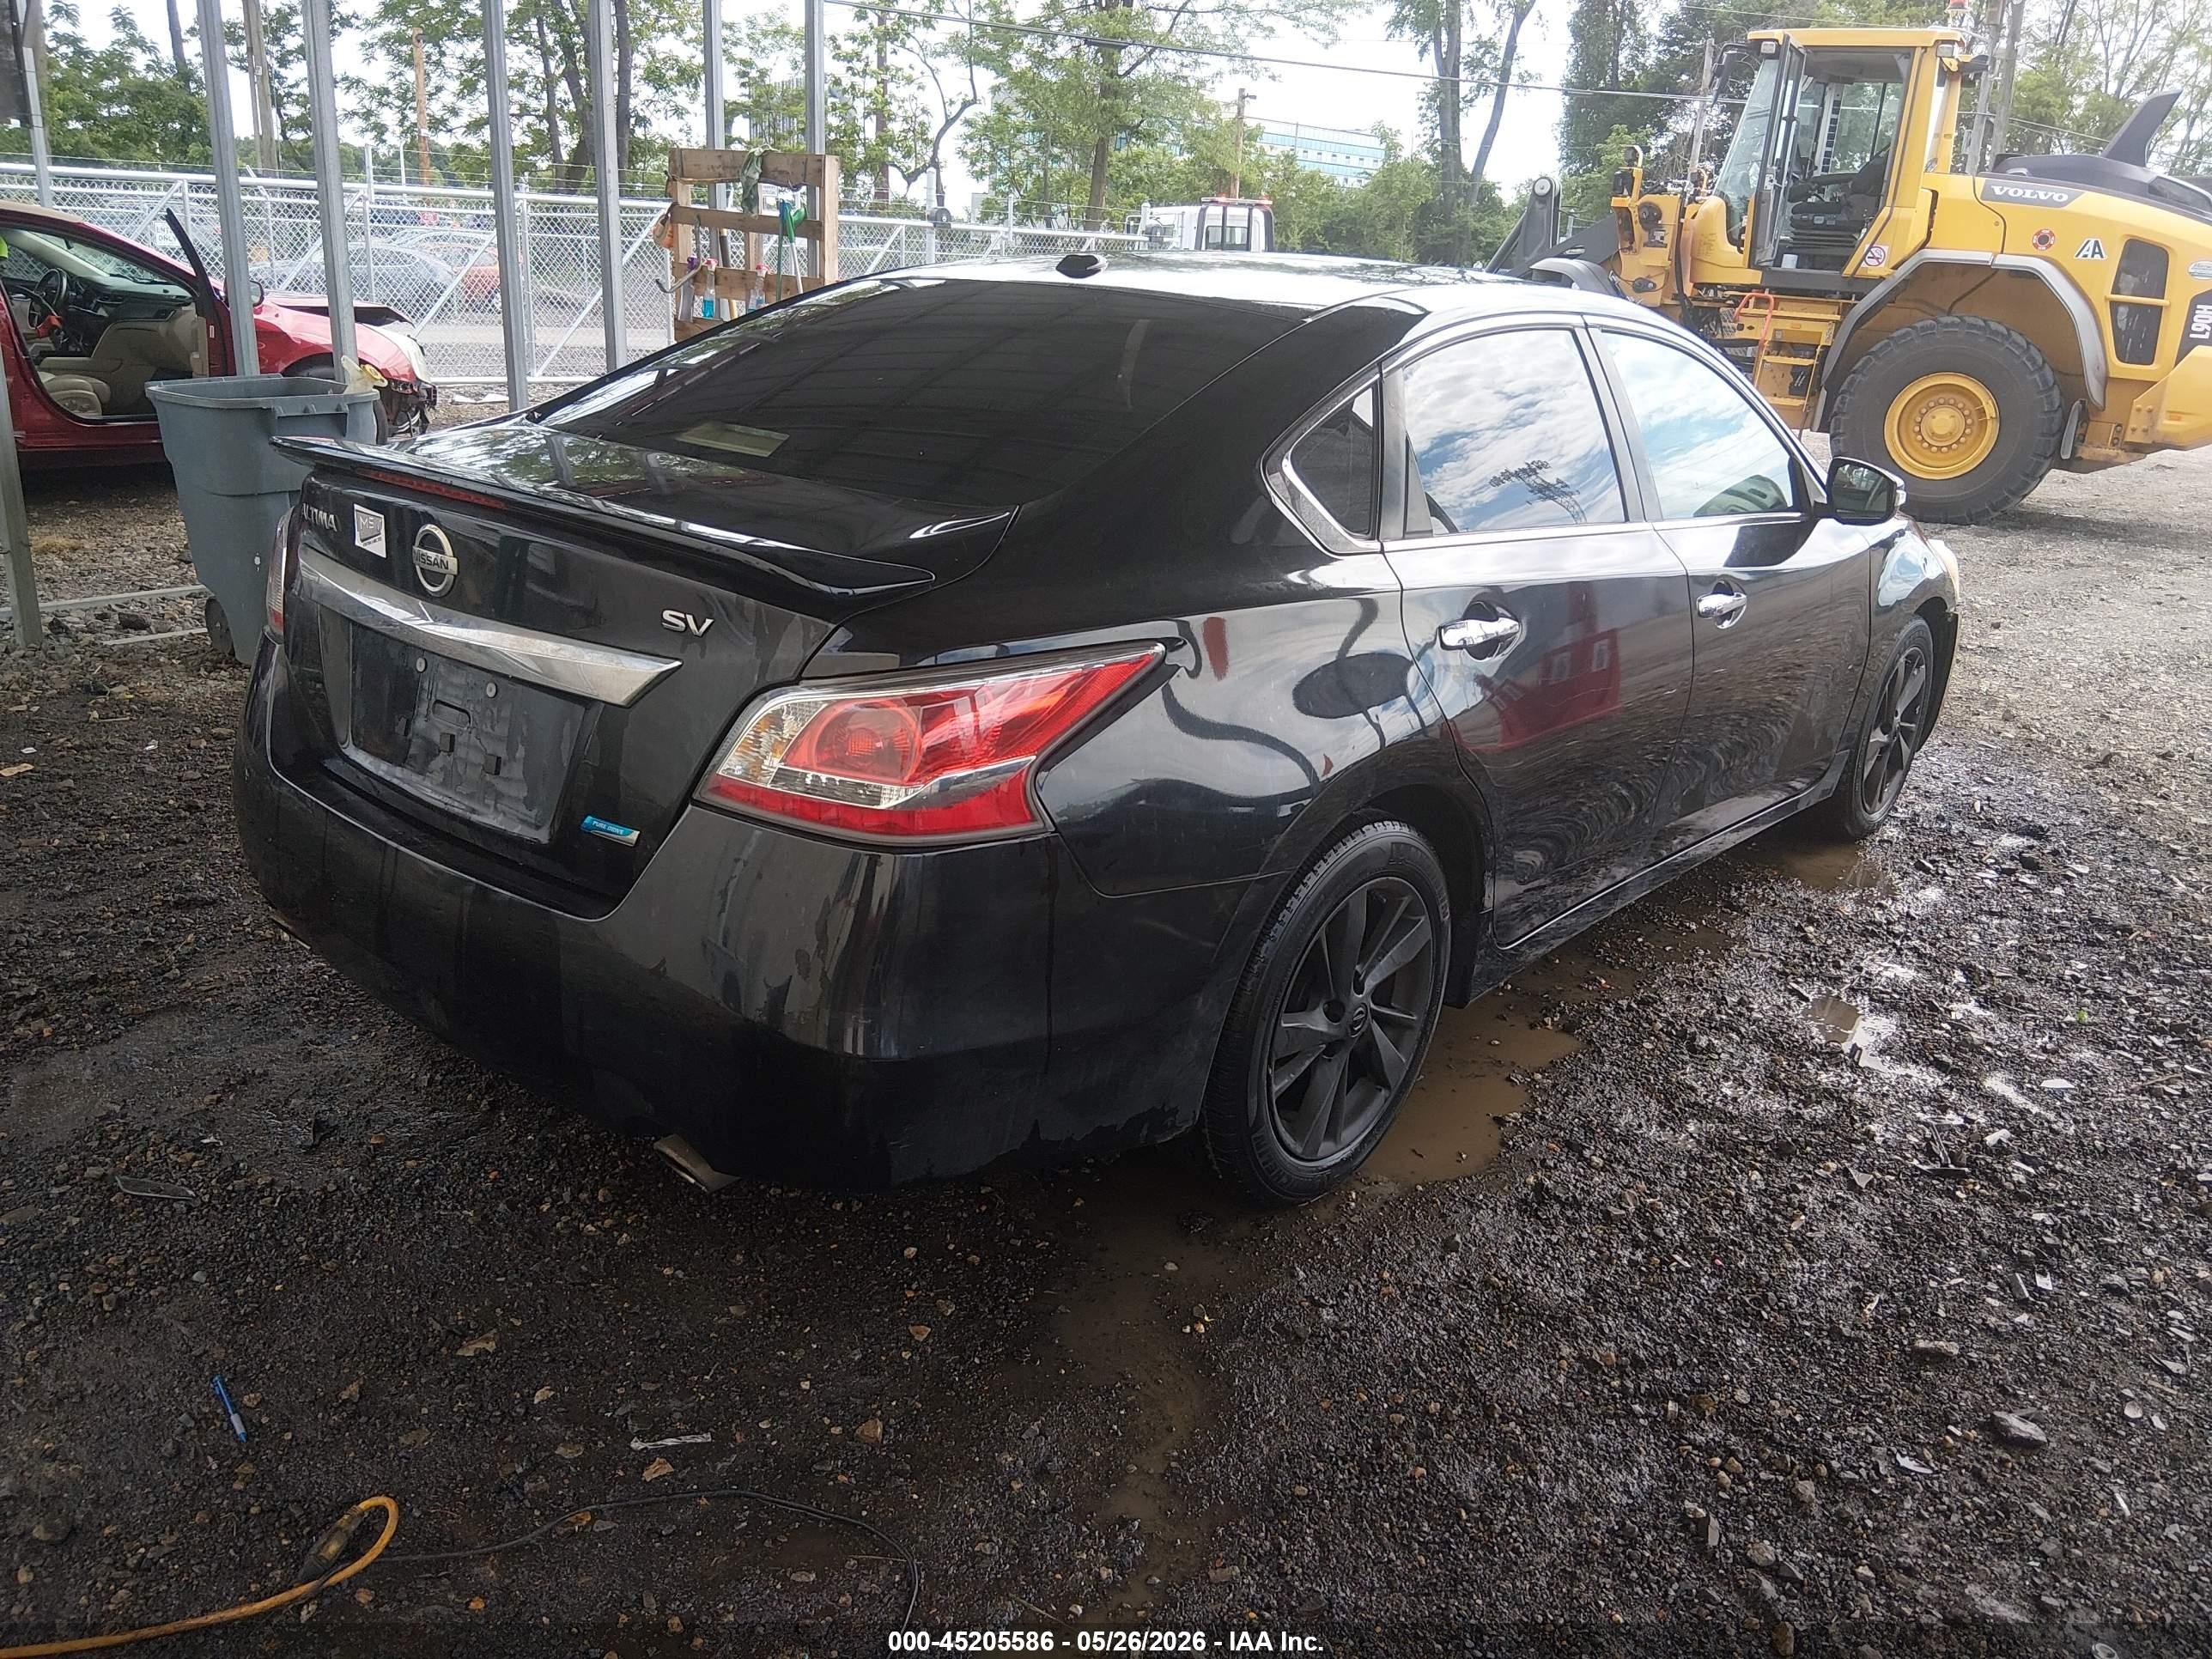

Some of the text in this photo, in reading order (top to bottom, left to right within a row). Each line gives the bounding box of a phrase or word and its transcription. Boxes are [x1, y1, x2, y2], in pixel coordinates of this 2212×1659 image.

[1990, 185, 2069, 203] VOLVO
[2189, 304, 2212, 339] L90H
[413, 550, 449, 570] NISSAN
[661, 610, 714, 637] SV
